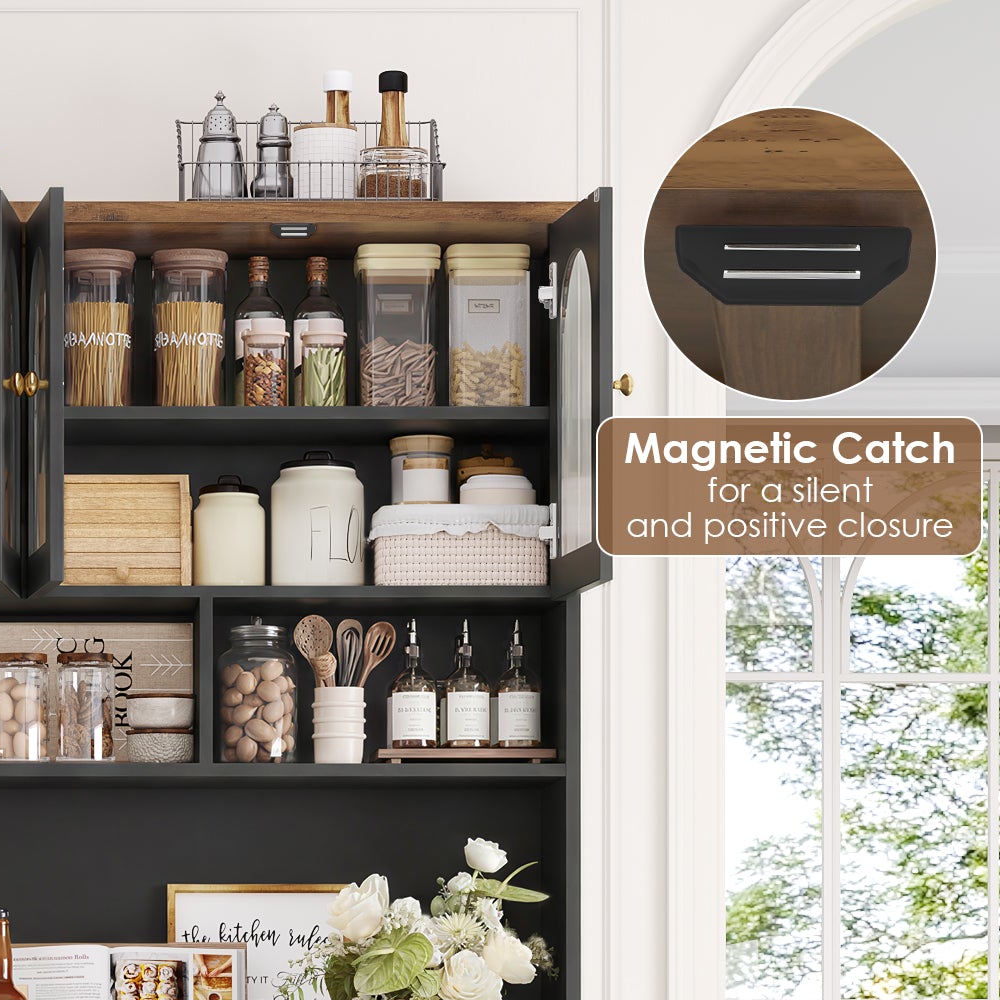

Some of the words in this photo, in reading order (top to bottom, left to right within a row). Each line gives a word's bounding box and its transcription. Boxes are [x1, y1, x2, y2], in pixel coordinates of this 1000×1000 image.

[309, 504, 364, 563] FLO
[181, 925, 212, 943] the
[218, 918, 281, 948] kitchen
[260, 975, 269, 984] IT
